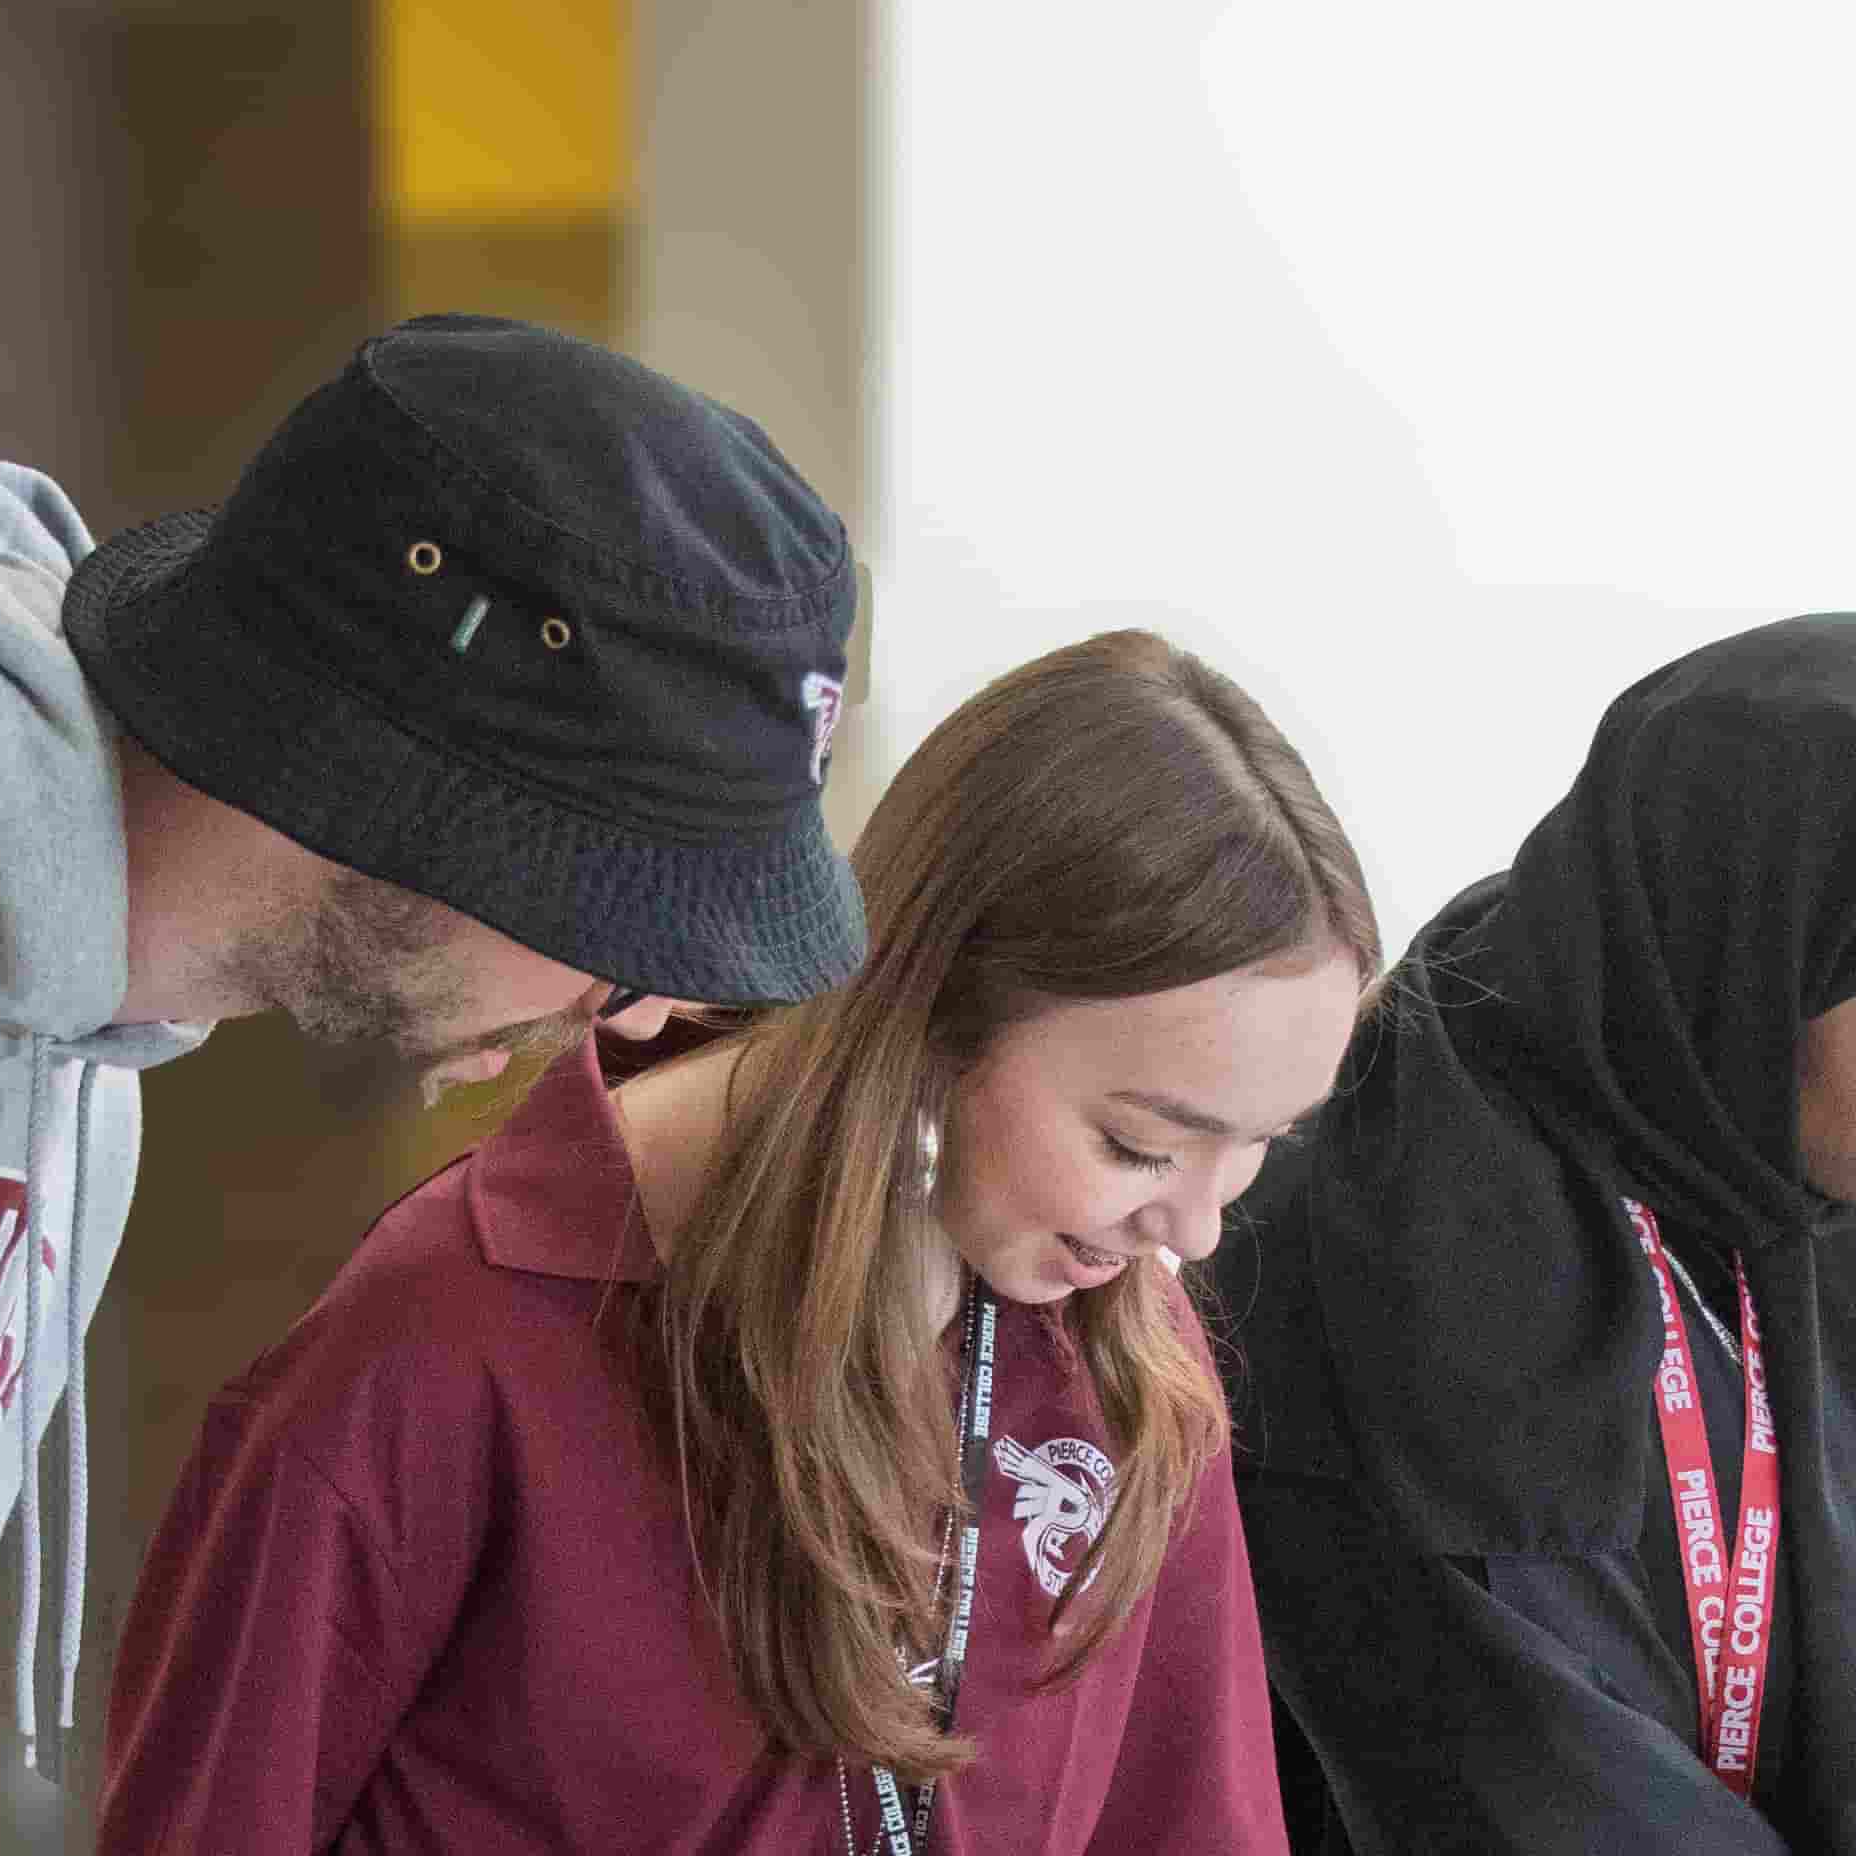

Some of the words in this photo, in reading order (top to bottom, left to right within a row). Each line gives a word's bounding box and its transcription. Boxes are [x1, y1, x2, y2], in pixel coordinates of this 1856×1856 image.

[1047, 1441, 1094, 1465] PIERCE
[1094, 1457, 1114, 1481] CO
[1676, 1469, 1723, 1587] PIERCE
[1729, 1505, 1774, 1656] COLLEGE
[1715, 1665, 1757, 1771] PIERCE
